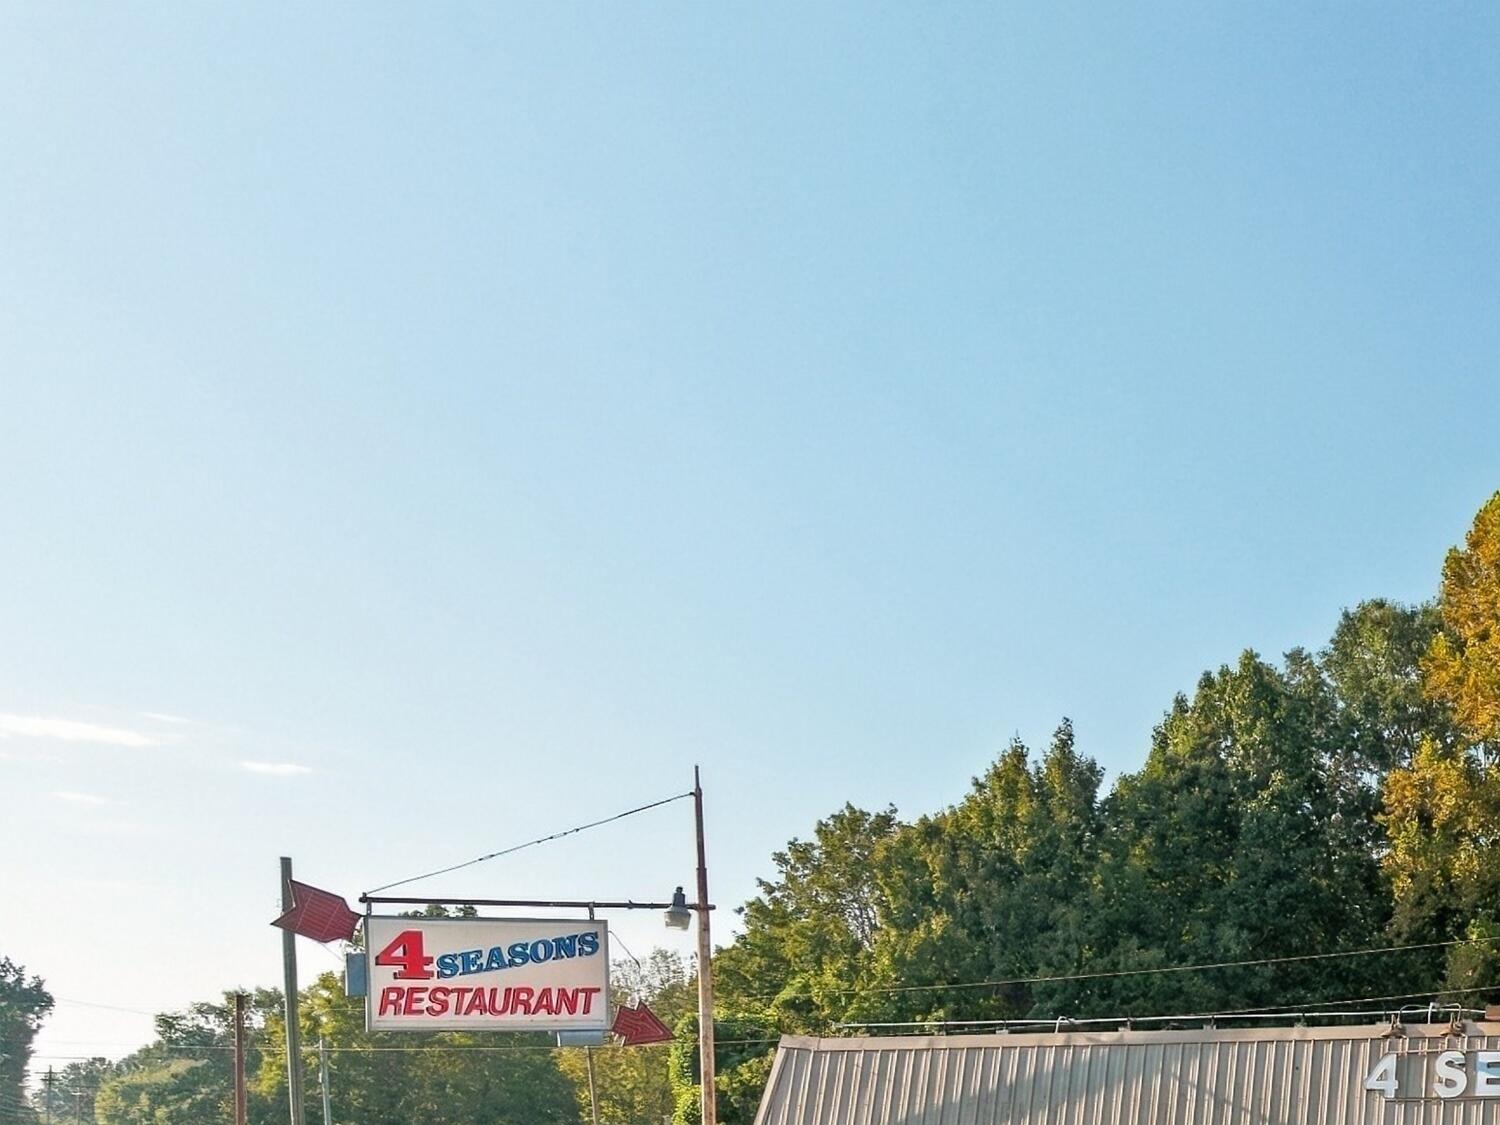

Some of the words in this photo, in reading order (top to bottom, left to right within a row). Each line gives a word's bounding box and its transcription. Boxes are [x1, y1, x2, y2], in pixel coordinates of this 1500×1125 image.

[375, 929, 434, 980] 4
[436, 931, 600, 980] SEASONS
[378, 986, 601, 1017] RESTAURANT
[1364, 1052, 1400, 1098] 4
